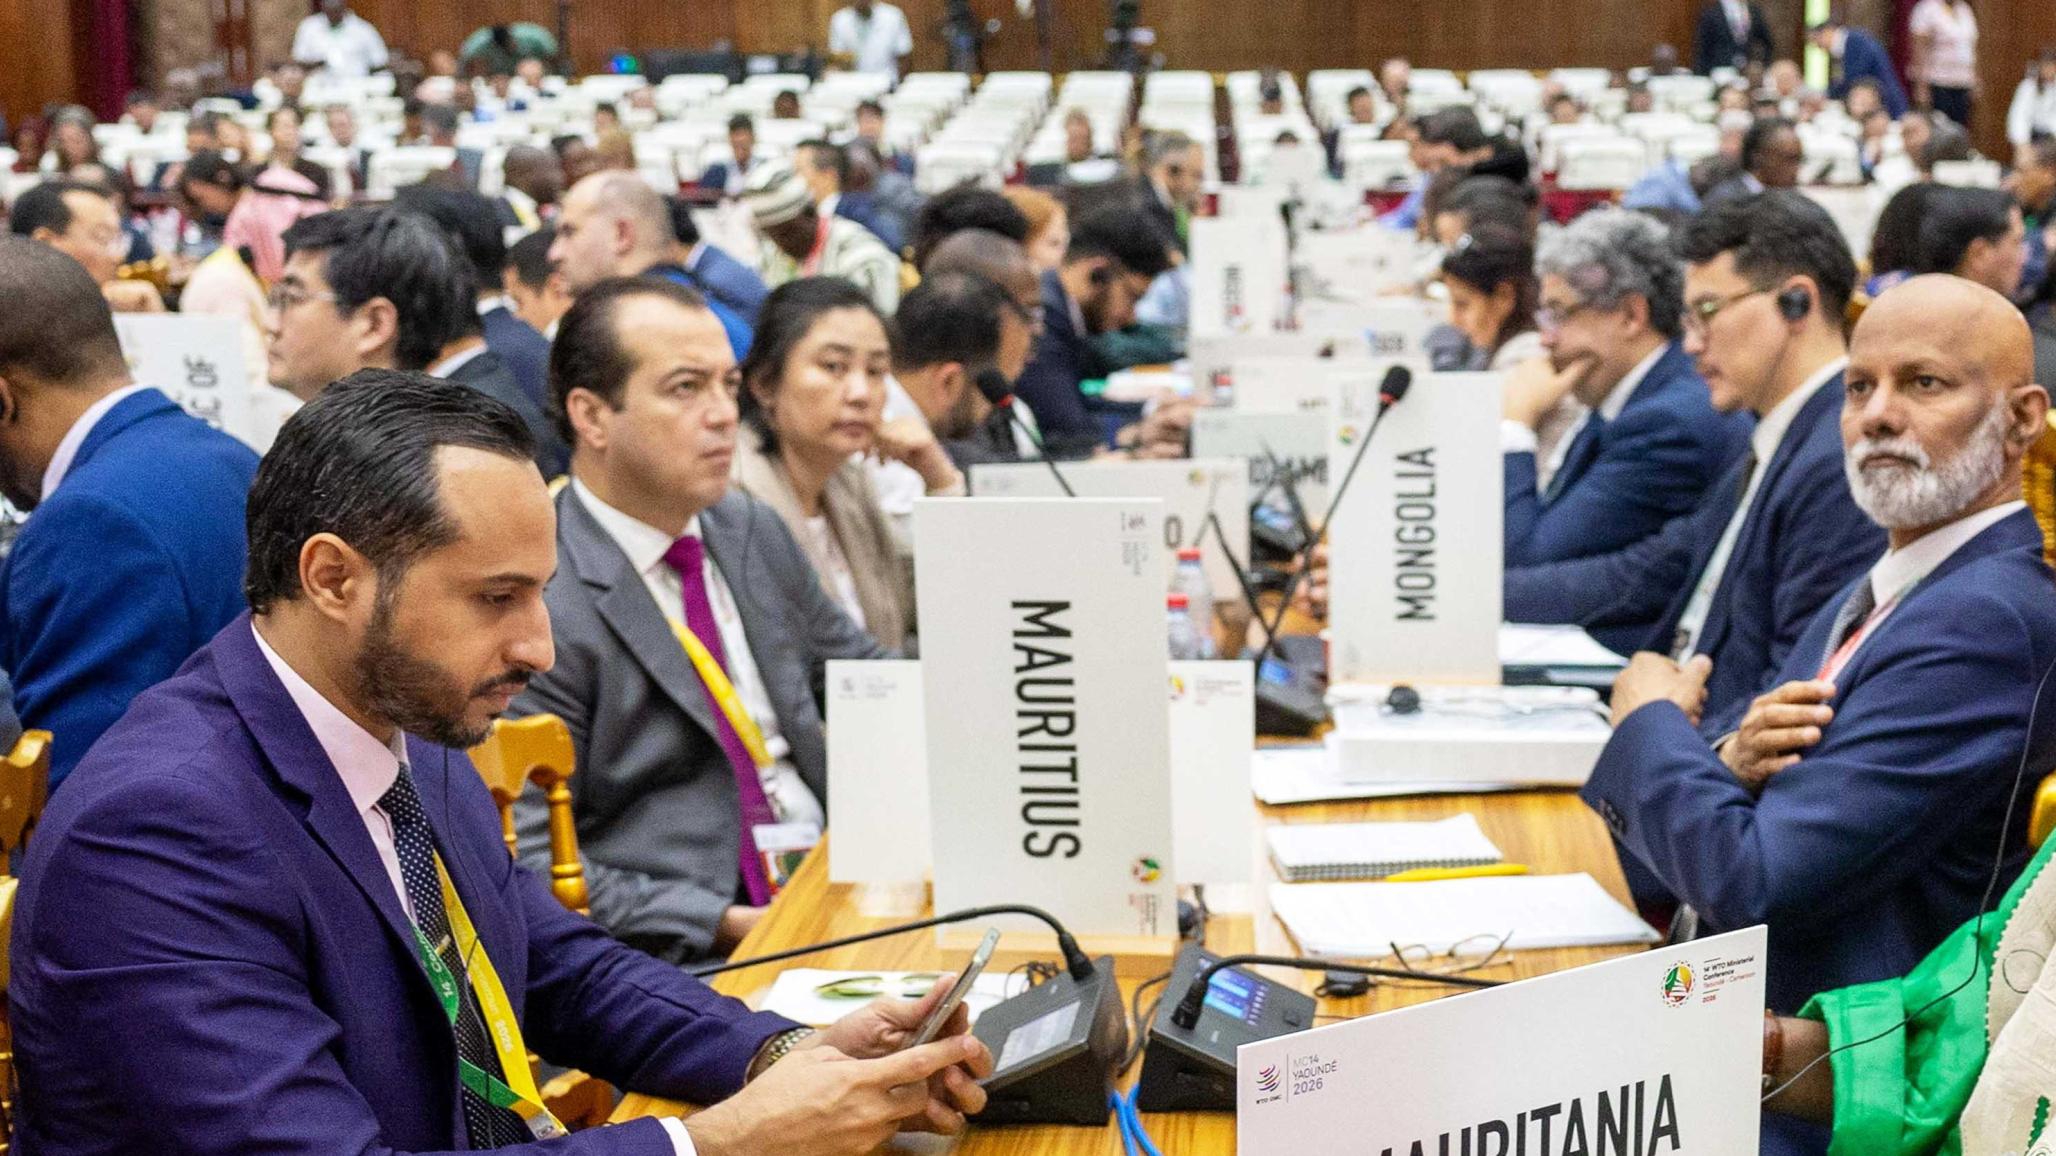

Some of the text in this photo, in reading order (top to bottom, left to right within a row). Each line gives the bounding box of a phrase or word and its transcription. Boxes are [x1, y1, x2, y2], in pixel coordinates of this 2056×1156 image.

[1394, 447, 1437, 621] MONGOLIA
[1010, 600, 1082, 860] MAURITIUS
[1703, 969, 1735, 981] Conference
[1292, 1059, 1338, 1081] YAOUNDÉ
[1293, 1077, 1324, 1096] 2026
[1378, 1074, 1681, 1156] RITANIA
